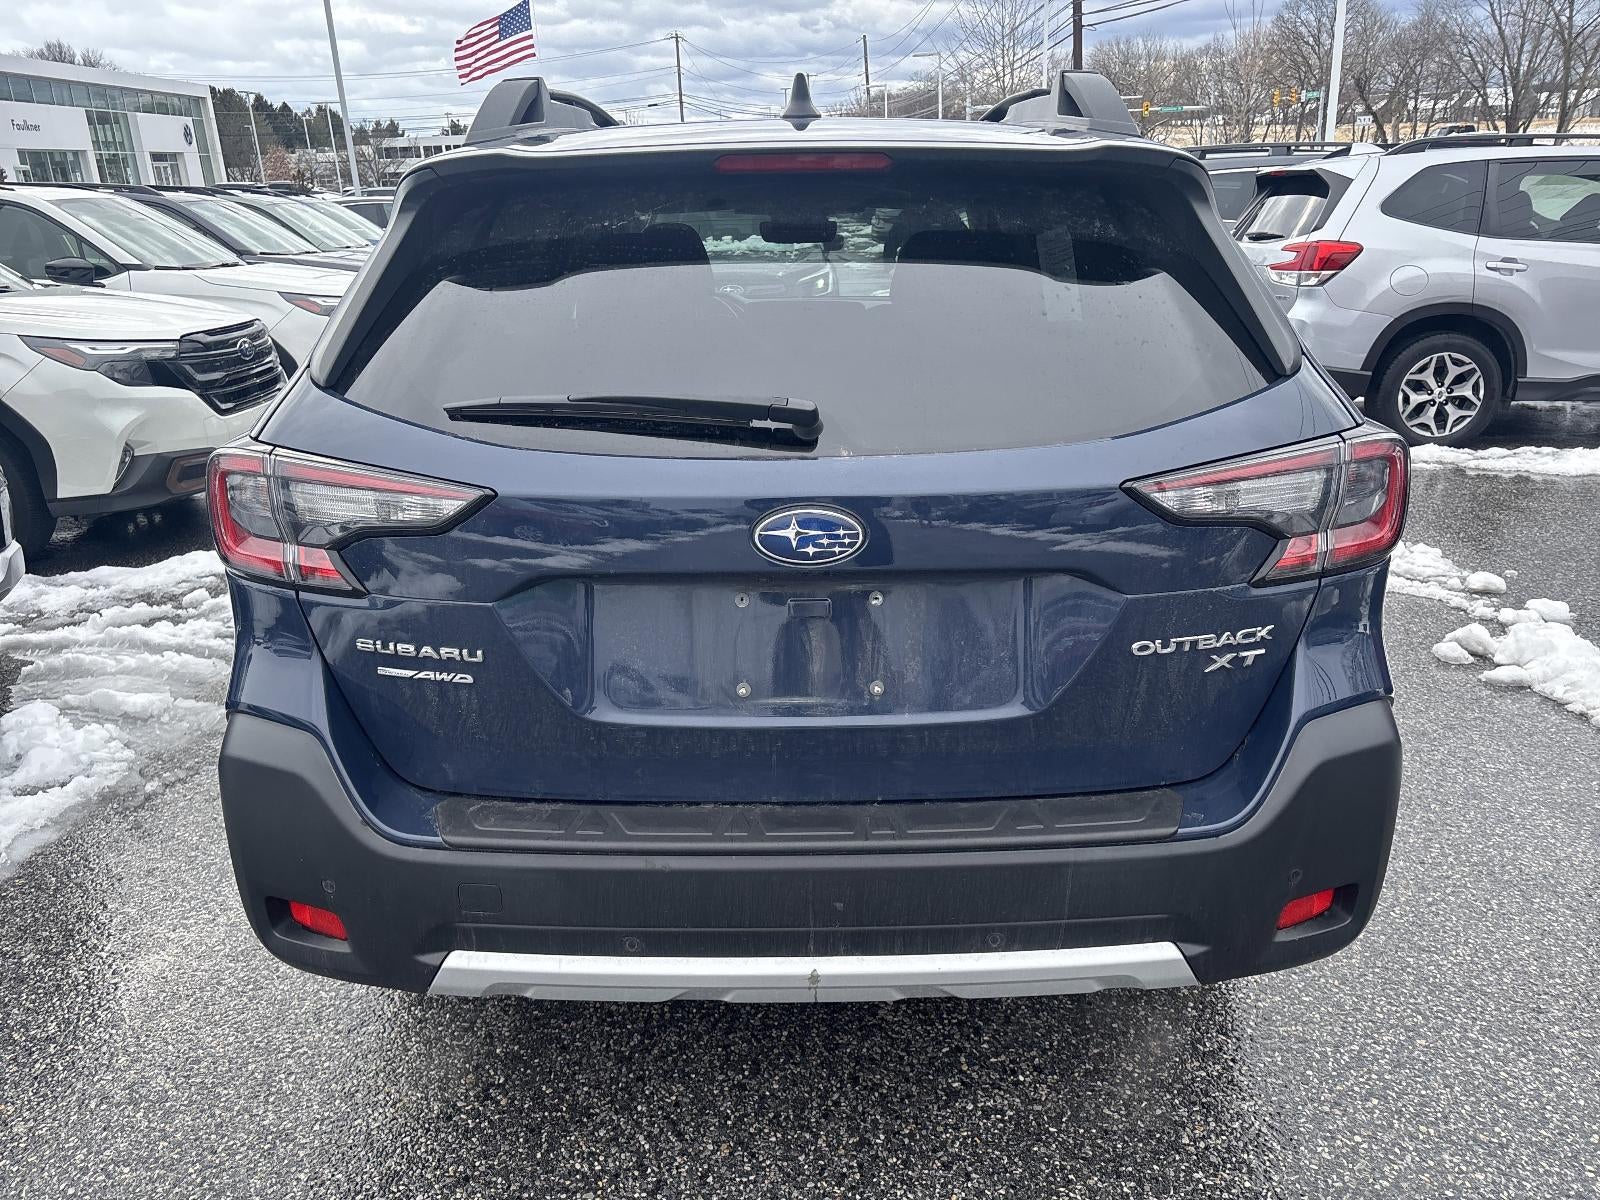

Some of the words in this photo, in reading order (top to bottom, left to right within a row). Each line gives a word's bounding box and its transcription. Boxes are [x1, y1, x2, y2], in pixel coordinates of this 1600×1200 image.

[10, 118, 41, 132] Faulkner
[355, 638, 484, 663] SUBARU
[1131, 624, 1275, 656] OUTBACK
[1204, 648, 1266, 673] XT
[413, 671, 474, 684] AWD
